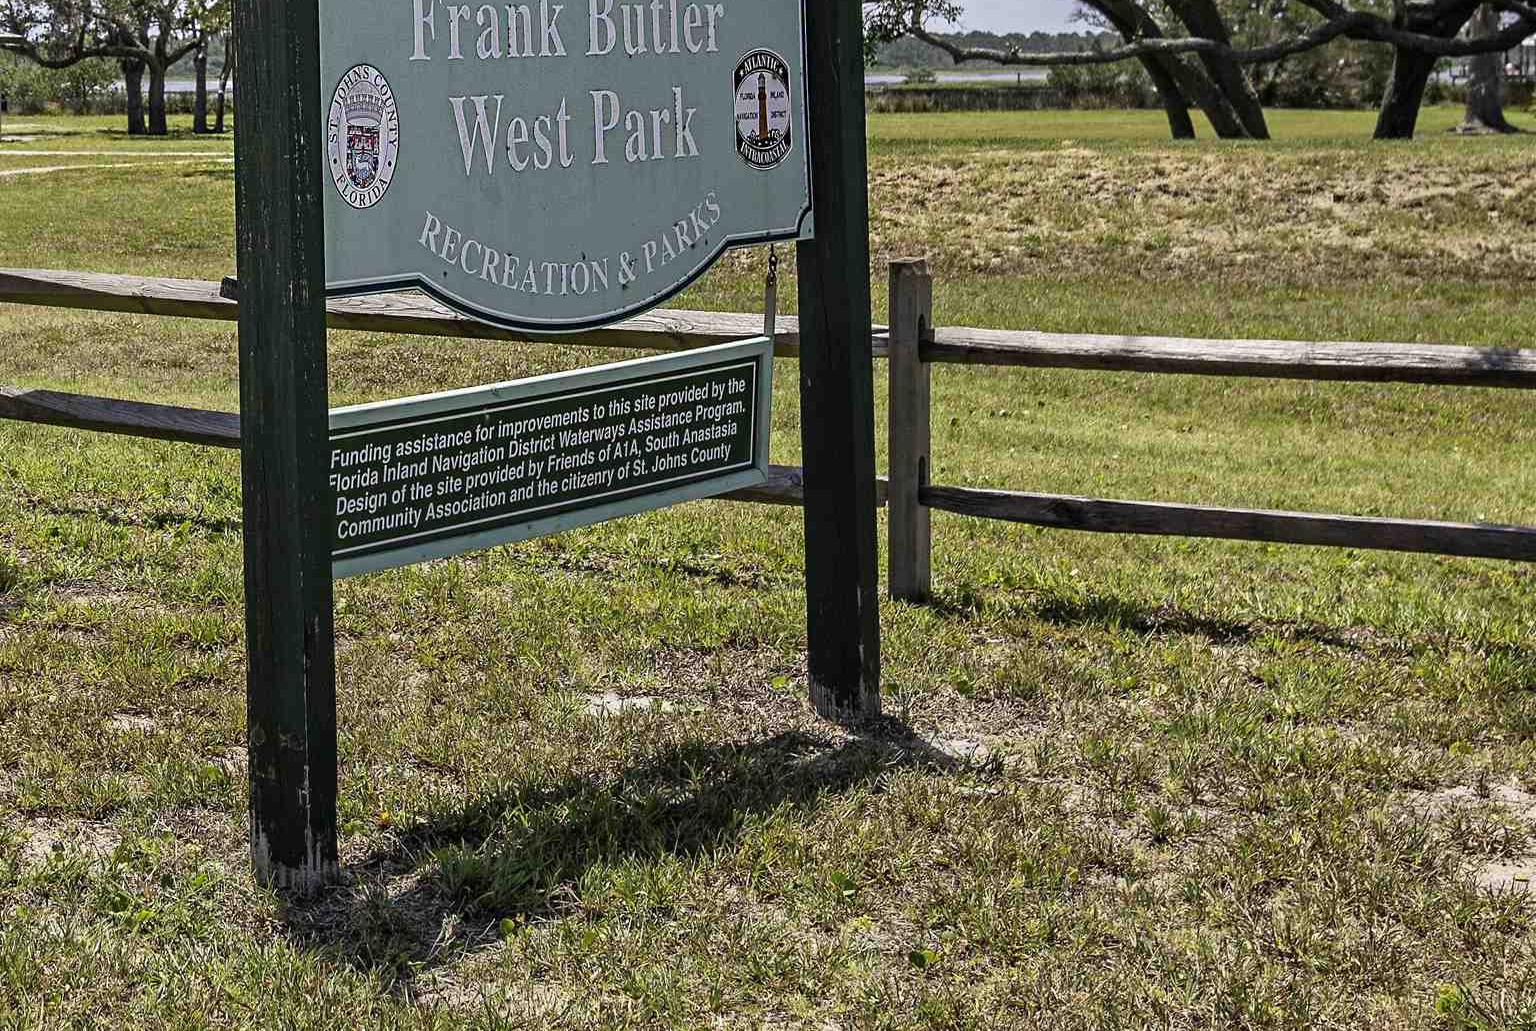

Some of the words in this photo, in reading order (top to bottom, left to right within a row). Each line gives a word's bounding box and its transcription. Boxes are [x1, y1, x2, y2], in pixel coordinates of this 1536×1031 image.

[334, 66, 369, 107] JOHNS
[374, 74, 397, 148] COUNTY
[744, 54, 779, 74] ATLANTIC
[448, 95, 575, 176] West
[589, 86, 700, 164] Park
[740, 141, 787, 163] INTRACOASTAL
[336, 173, 388, 206] FLORIDA
[418, 210, 609, 295] RECREATION
[618, 251, 637, 284] &
[642, 192, 721, 274] PARKS
[330, 443, 391, 469] Funding
[396, 429, 472, 457] assistance
[475, 424, 495, 442] for
[498, 407, 589, 439] improvements
[593, 404, 605, 420] to
[608, 398, 630, 417] this
[634, 394, 656, 412] site
[658, 382, 709, 412] provided
[711, 381, 725, 400] by
[728, 378, 745, 394] the
[383, 457, 428, 483] Inland
[432, 446, 504, 473] Navigation
[509, 433, 555, 458] District
[559, 423, 625, 448] Waterways
[628, 411, 692, 435] Assistance
[695, 400, 745, 422] Program.
[336, 491, 387, 516] Design
[391, 484, 407, 504] of
[410, 482, 433, 501] the
[436, 476, 462, 496] site
[465, 461, 524, 493] provided
[527, 460, 544, 479] by
[547, 448, 595, 473] Friends
[598, 444, 611, 462] of
[613, 438, 641, 460] A1A,
[645, 431, 679, 452] South
[682, 420, 737, 445] Anastasia
[337, 506, 422, 539] Community
[425, 490, 506, 521] Association
[509, 481, 534, 503] and
[538, 478, 558, 497] the
[561, 468, 614, 492] citizenry
[617, 461, 630, 480] of
[633, 459, 648, 477] St.
[652, 453, 687, 473] Johns
[690, 442, 731, 464] County
